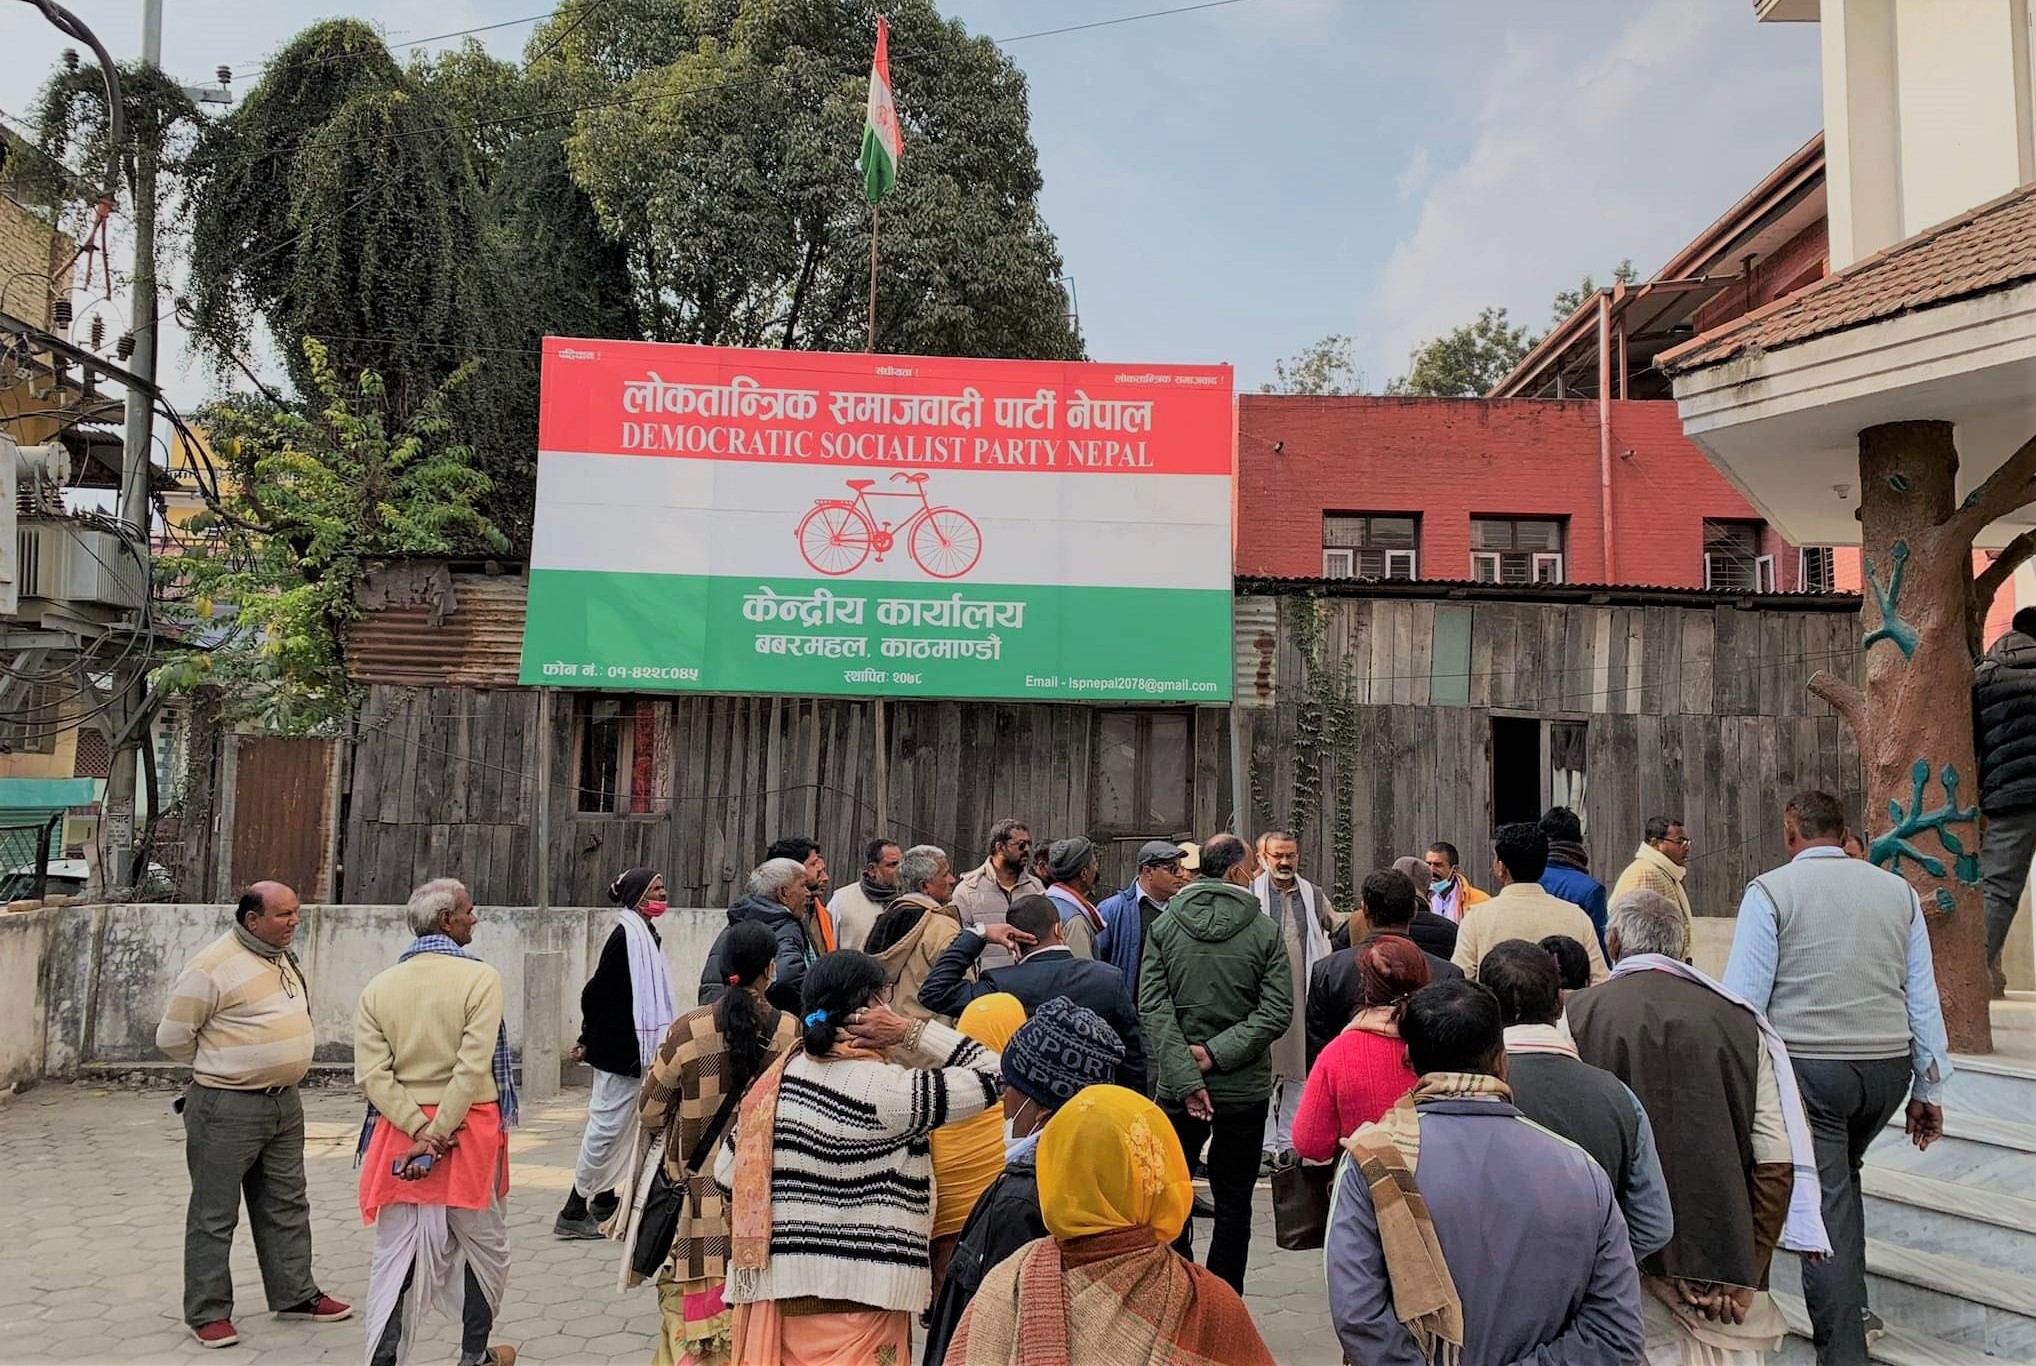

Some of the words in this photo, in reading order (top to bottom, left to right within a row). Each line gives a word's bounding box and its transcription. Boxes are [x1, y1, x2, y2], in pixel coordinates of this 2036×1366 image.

[622, 371, 820, 421] लोकतान्त्रिक
[828, 387, 984, 431] समाजवादी
[994, 389, 1057, 431] पार्टी
[1066, 390, 1154, 433] नेपाल
[621, 421, 813, 457] DEMOCRATIC
[820, 431, 966, 463] SOCIALIST
[973, 437, 1060, 466] PARTY
[1067, 440, 1154, 467] NEPAL
[743, 586, 866, 627] केन्द्रीय
[876, 593, 1026, 630] कार्यालय
[880, 633, 1003, 661] काठमाण्डौ
[543, 661, 578, 677] फोन
[893, 672, 922, 684] २०७८
[1025, 674, 1058, 688] Email
[1069, 676, 1217, 694] lspnepal2078@gmail.com
[1027, 1027, 1114, 1079] SPORT
